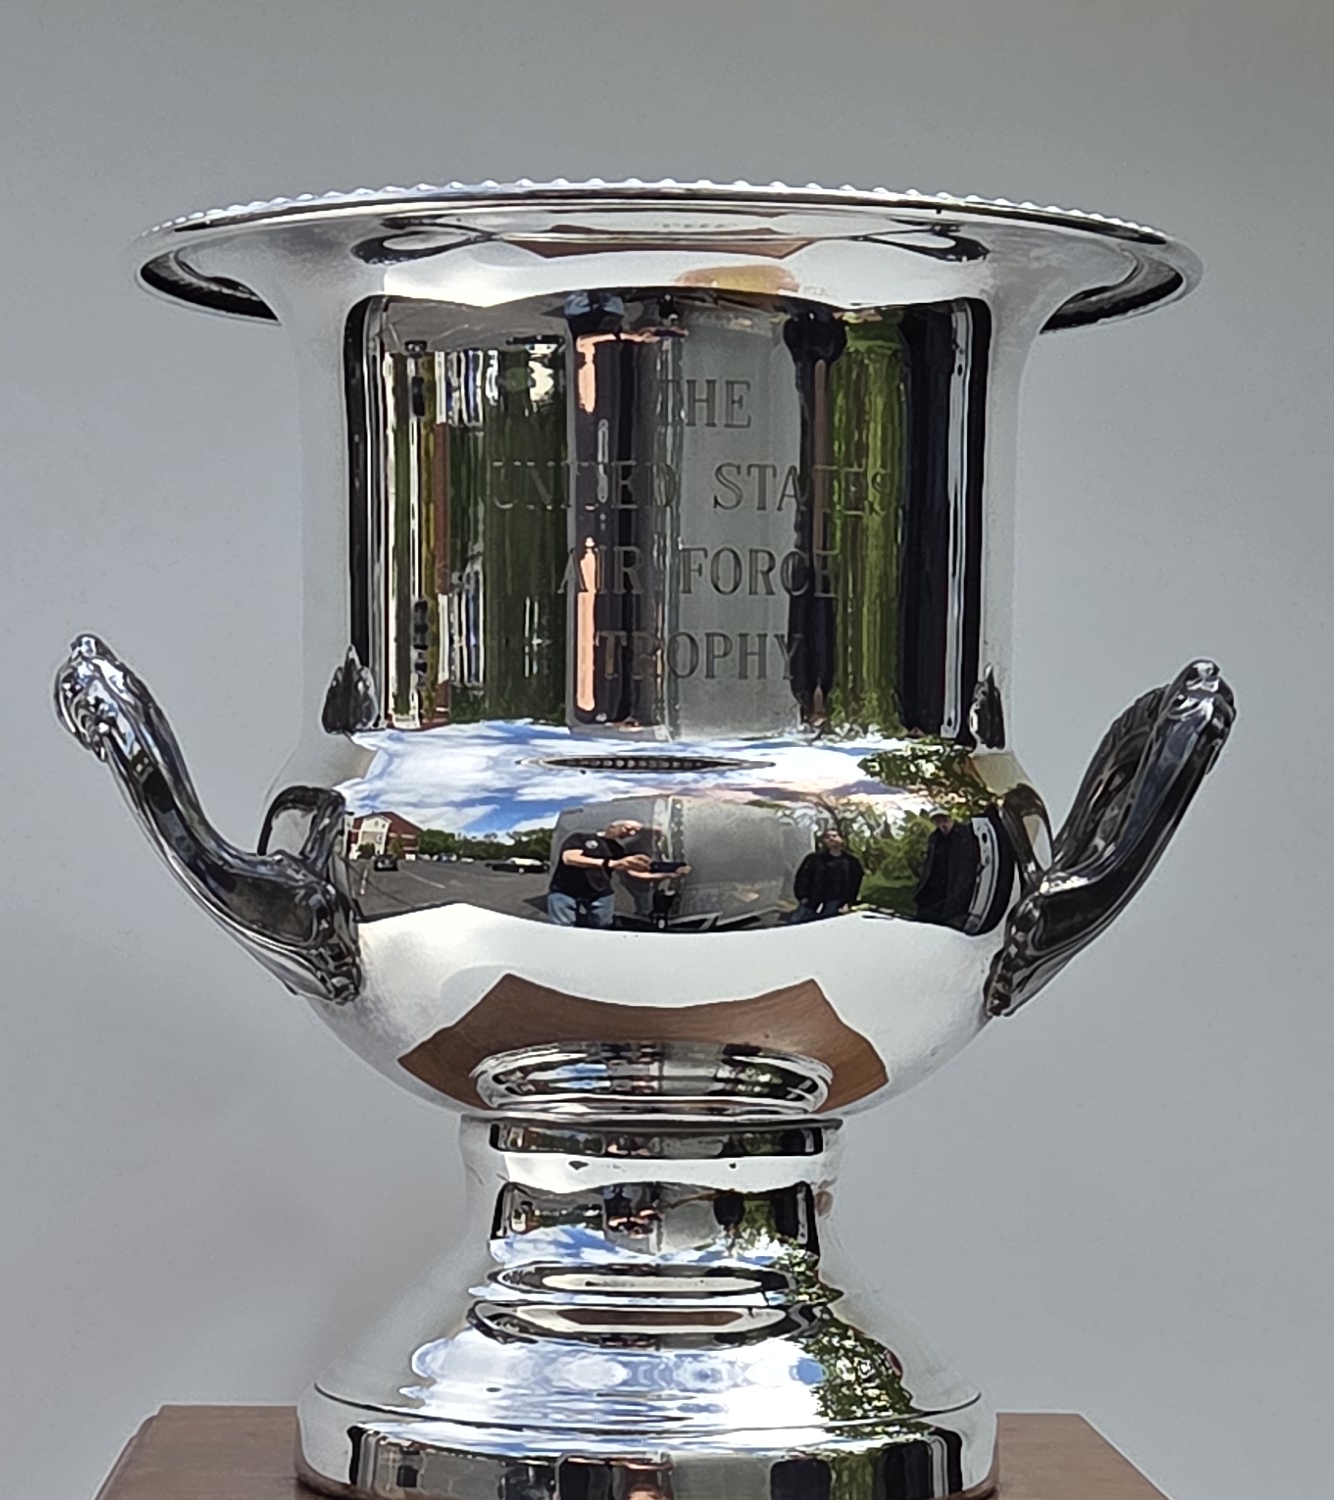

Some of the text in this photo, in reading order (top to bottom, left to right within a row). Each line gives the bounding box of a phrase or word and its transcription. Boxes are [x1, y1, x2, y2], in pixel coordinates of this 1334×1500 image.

[656, 378, 752, 429] THE
[557, 545, 839, 598] AIR FORCE
[595, 630, 804, 681] TROPHY
